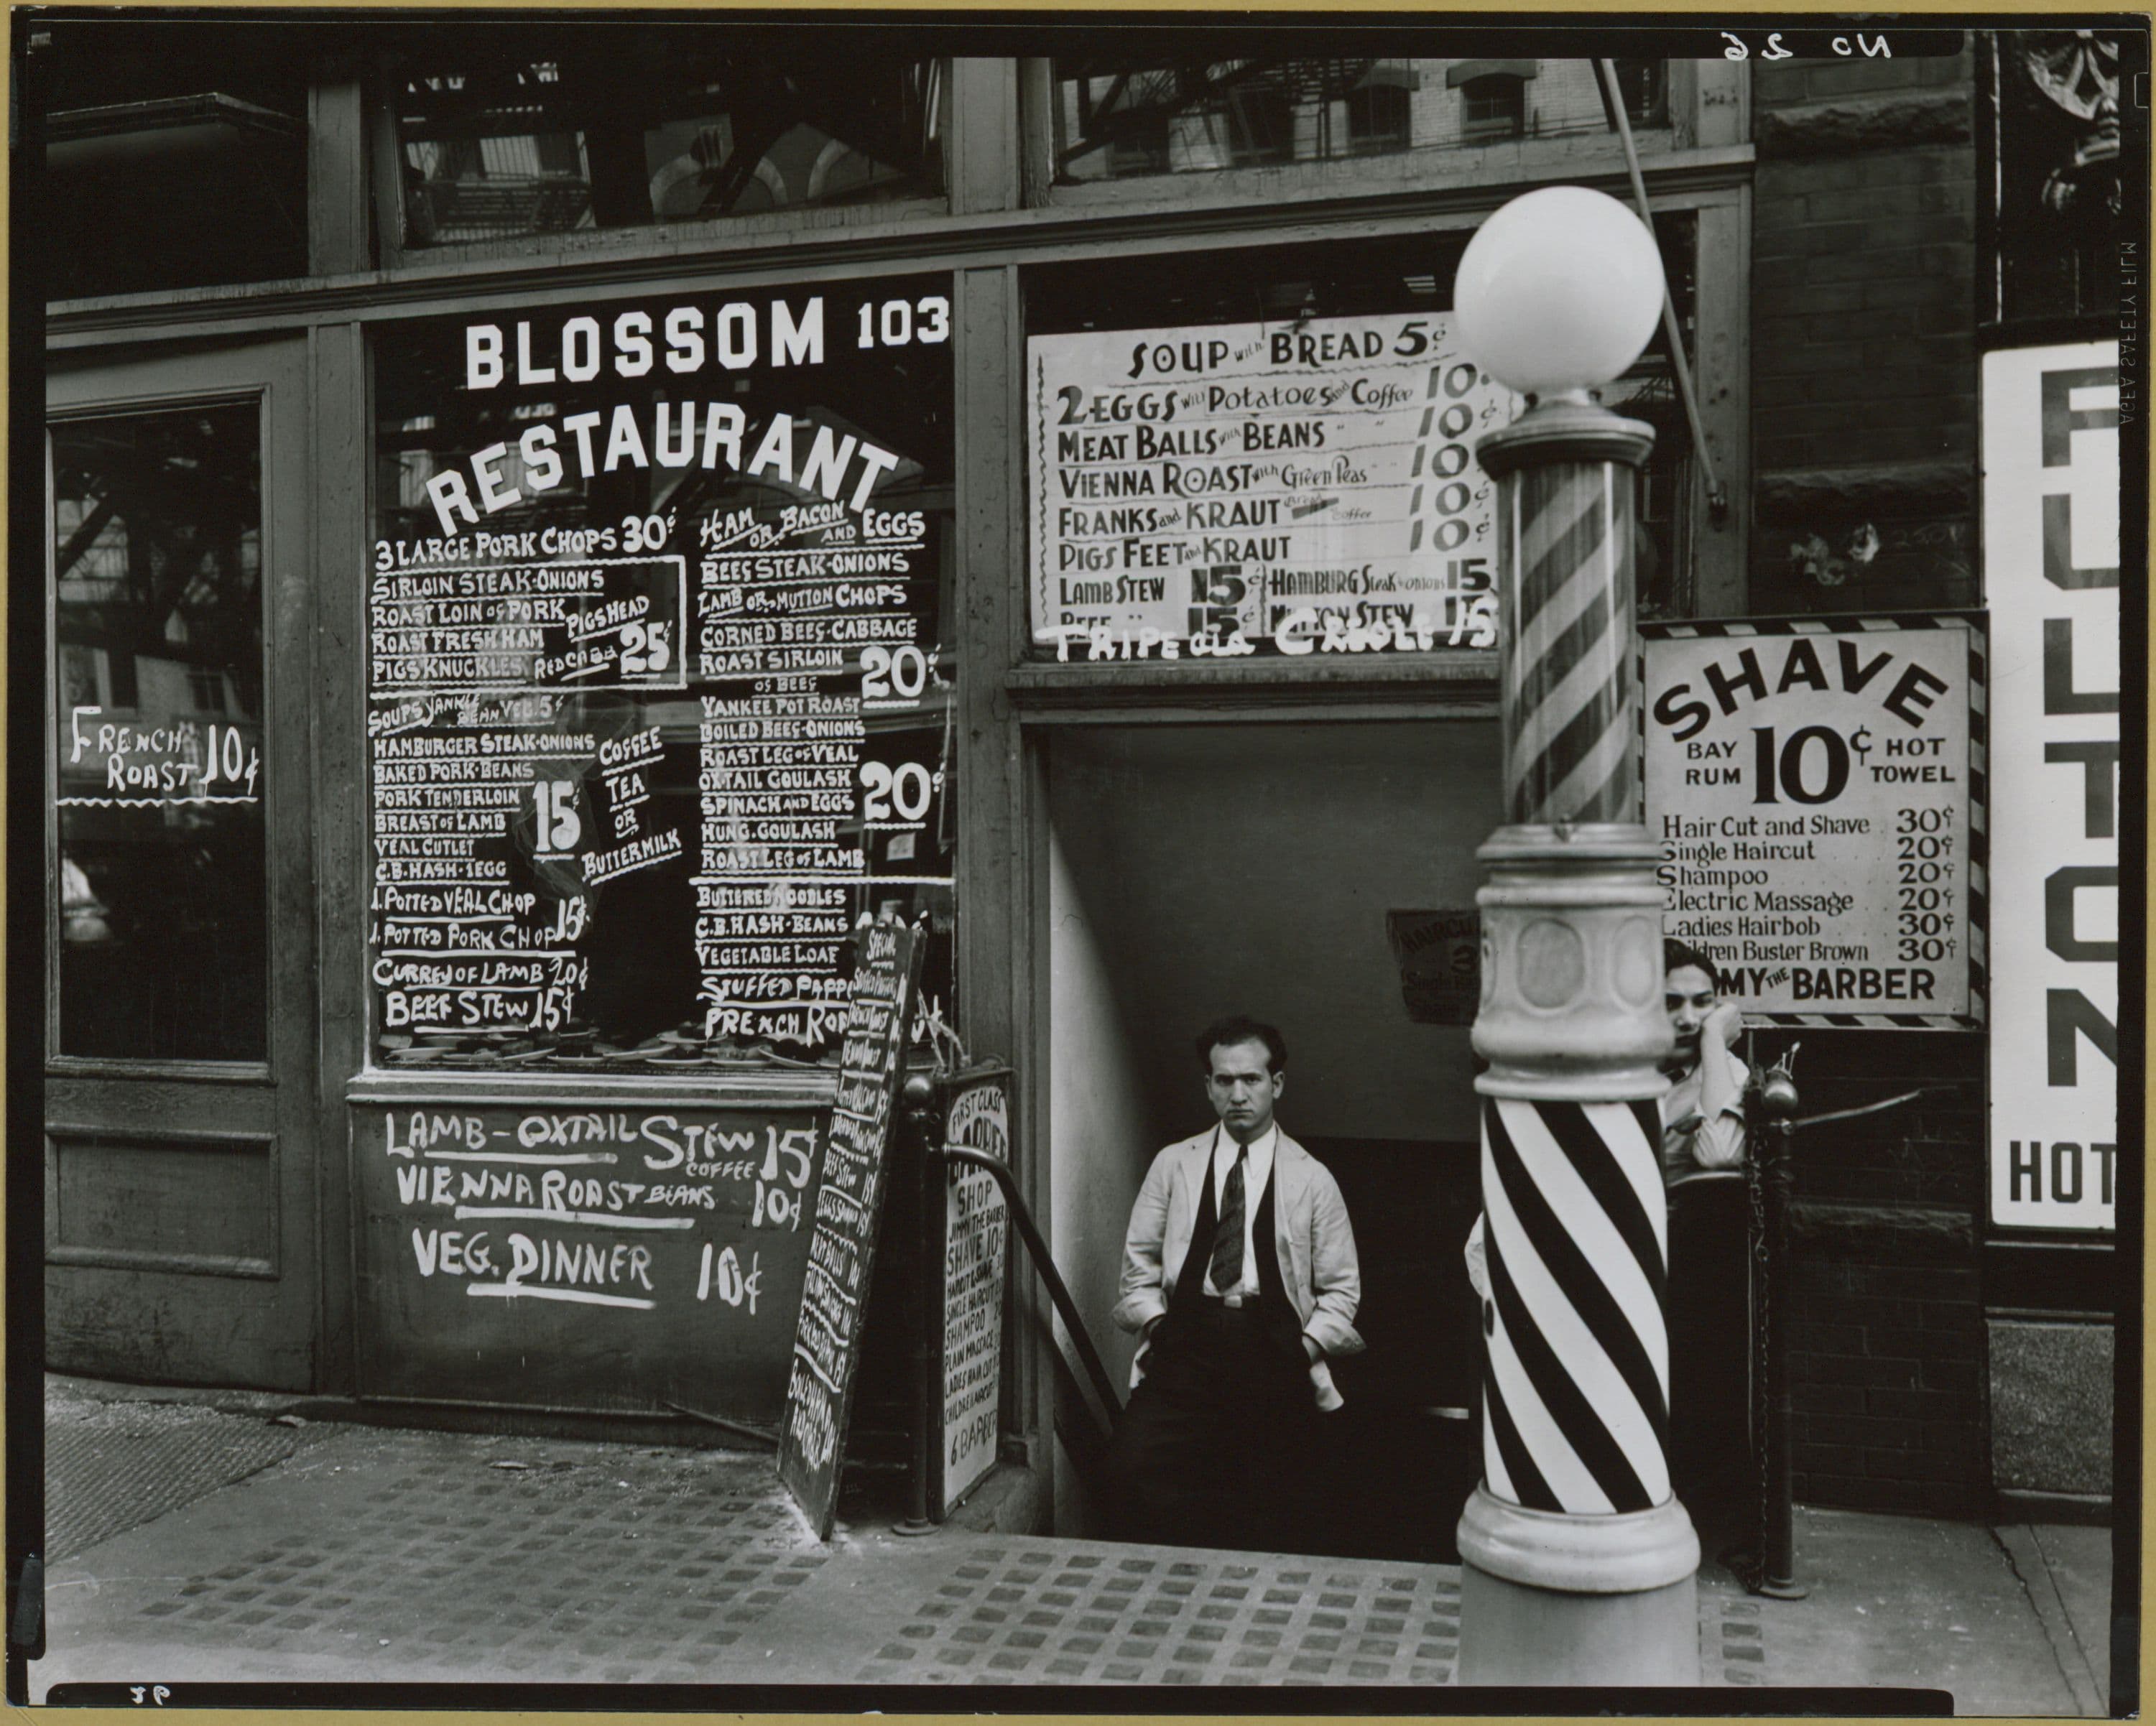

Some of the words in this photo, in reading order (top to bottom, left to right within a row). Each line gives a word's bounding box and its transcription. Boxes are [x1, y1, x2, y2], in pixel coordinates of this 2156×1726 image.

[466, 297, 825, 390] BLOSSOM
[858, 296, 950, 349] 103
[1127, 340, 1229, 379] SOUP
[1271, 331, 1382, 368] BREAD
[1058, 431, 1129, 463] MEAT
[1137, 425, 1217, 460] BALLS
[1244, 421, 1325, 451] BEANS
[425, 401, 899, 538] RESTAURANT
[1058, 469, 1155, 498] VIENNA
[1162, 463, 1253, 499] ROAST
[1281, 464, 1331, 488] Green
[1332, 455, 1367, 484] Peas
[700, 507, 754, 547] HAM
[780, 501, 845, 532] BACON
[821, 525, 856, 542] AND
[862, 508, 926, 537] EGGS
[1058, 507, 1157, 537] FRANKS
[1159, 508, 1182, 527] and
[1186, 499, 1280, 529] KRAUT
[376, 541, 394, 570] 3
[397, 537, 469, 566] LARGE
[476, 532, 537, 559] PORK
[541, 526, 617, 555] CHOPS
[1059, 544, 1117, 571] PIGS
[1123, 539, 1187, 568] FEET
[1203, 537, 1290, 563] KRAUT
[698, 588, 744, 618] LAMB
[777, 586, 833, 610] MUTTON
[835, 583, 907, 608] CHOPS
[1060, 577, 1113, 606] LAMB
[1116, 575, 1165, 604] STEW
[603, 595, 649, 625] HEAD
[371, 631, 432, 653] ROAST
[432, 628, 501, 651] FRESH
[501, 628, 545, 648] HAM
[700, 622, 776, 648] CORNED
[1035, 623, 1179, 662] TRIPE
[373, 660, 420, 680] PIGS
[422, 656, 523, 679] KNUCKLES
[700, 649, 763, 675] ROAST
[767, 648, 844, 669] SIRLOIN
[1653, 638, 1949, 742] SHAVE
[700, 695, 772, 718] YANKEE
[776, 698, 805, 715] POT
[808, 696, 860, 715] ROAST
[70, 705, 182, 764] FRENCH
[373, 737, 477, 758] HAMBURGER
[599, 726, 663, 766] COFFEE
[1688, 741, 1738, 759] BAY
[1887, 738, 1946, 756] HOT
[107, 753, 198, 792] ROAST
[606, 773, 645, 804] TEA
[767, 769, 851, 789] GOULASH
[1685, 768, 1741, 786] RUM
[1870, 766, 1956, 783] TOWEL
[374, 789, 422, 808] PORK
[427, 786, 520, 807] TENDERLOIN
[700, 795, 782, 816] SPINACH
[782, 796, 809, 810] AND
[810, 793, 855, 812] EGGS
[614, 808, 638, 833] OR
[1662, 815, 1716, 839] Hair
[1721, 815, 1759, 838] Cut
[1765, 815, 1805, 836] and
[1810, 815, 1871, 835] Shave
[374, 840, 420, 857] VEAL
[422, 838, 474, 856] CUTLET
[581, 827, 683, 882] BUTTERMILK
[1660, 840, 1728, 868] Single
[1734, 840, 1815, 860] Haircut
[1656, 865, 1769, 888] Shampoo
[1663, 888, 1749, 912] Electric
[1754, 891, 1854, 917] Massage
[1662, 914, 1733, 936] Ladies
[1738, 916, 1820, 937] Hairbob
[695, 944, 791, 966] VEGETABLE
[794, 945, 839, 964] LOAF
[1743, 942, 1805, 960] Buster
[1810, 942, 1869, 961] Brown
[455, 969, 478, 985] OF
[480, 961, 544, 985] LAMB
[1766, 967, 1790, 988] THE
[1792, 968, 1935, 1000] BARBER
[386, 990, 451, 1027] BEEF
[458, 990, 529, 1024] STEW
[952, 1091, 976, 1135] FIRST
[978, 1088, 1004, 1114] CLASS
[686, 1160, 754, 1180] COFFEE
[397, 1164, 535, 1206] VIENNA
[541, 1169, 644, 1212] ROAST
[957, 1179, 992, 1217] SHOP
[949, 1220, 971, 1243] JIMMY
[972, 1208, 985, 1229] THE
[412, 1228, 499, 1277] VEG.
[506, 1233, 654, 1291] DINNER
[947, 1232, 983, 1278] SHAVE
[945, 1308, 986, 1350] SHAMPOO
[945, 1348, 965, 1373] PLAIN
[950, 1434, 958, 1467] 6
